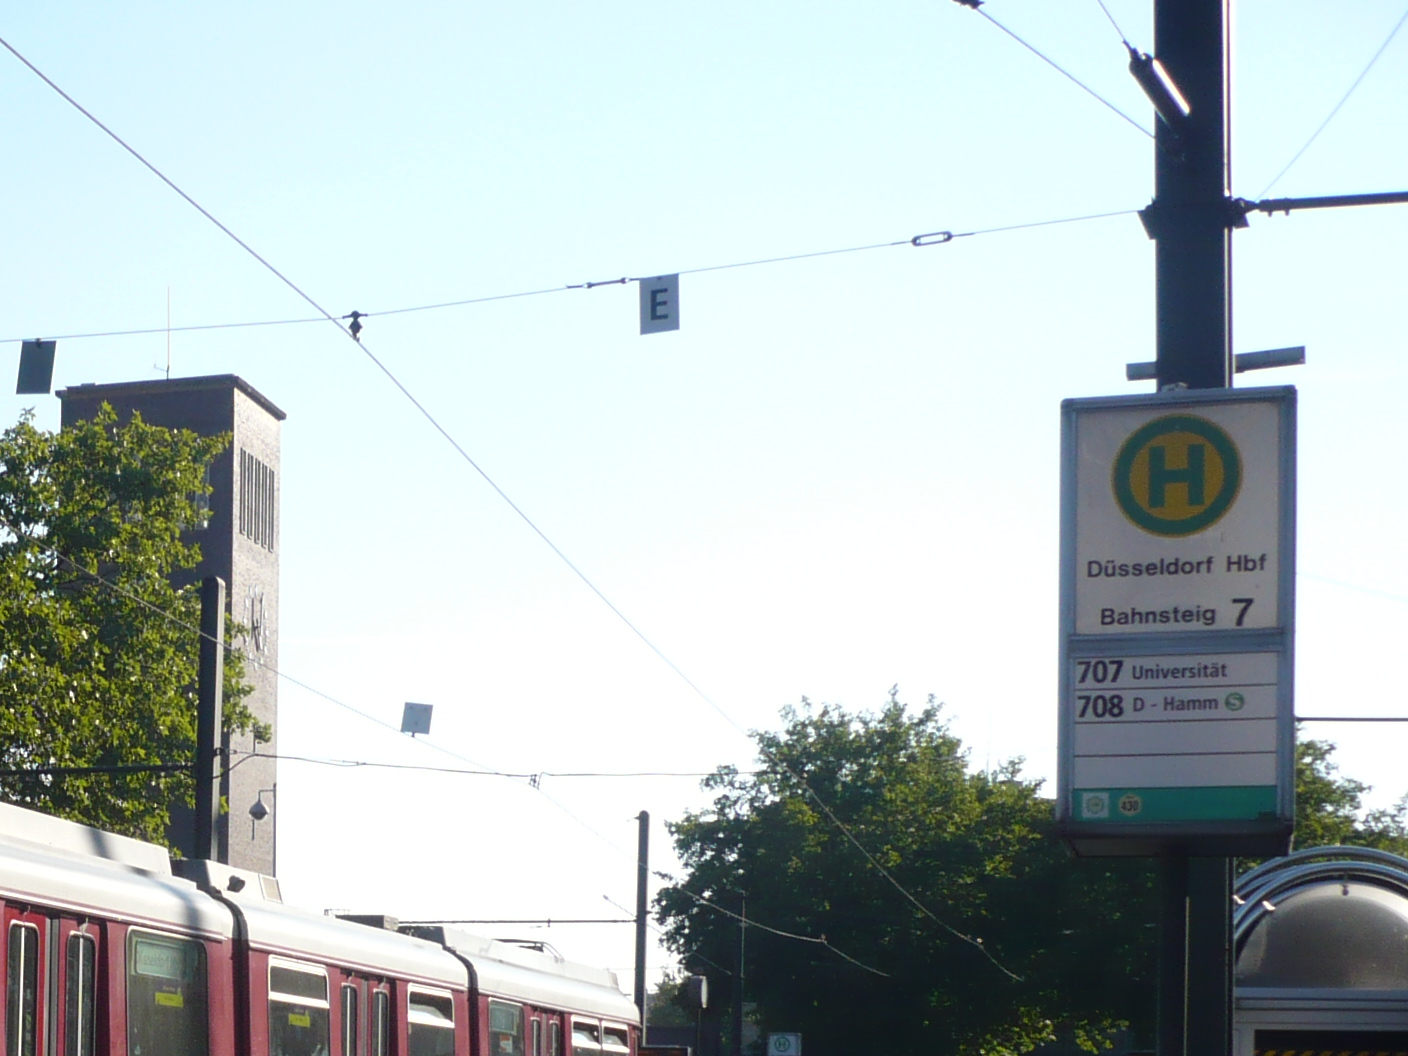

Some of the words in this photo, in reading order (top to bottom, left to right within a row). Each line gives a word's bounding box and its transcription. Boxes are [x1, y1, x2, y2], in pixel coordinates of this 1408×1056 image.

[650, 287, 669, 321] E
[1148, 443, 1205, 508] H
[1086, 556, 1214, 578] Düsseldorf
[1225, 553, 1267, 573] Hbf
[1100, 605, 1217, 626] Bahnsteig
[1231, 598, 1255, 627] 7
[1077, 660, 1124, 684] 707
[1132, 662, 1228, 680] Universität
[1077, 694, 1124, 718] 708
[1163, 696, 1219, 711] Hamm
